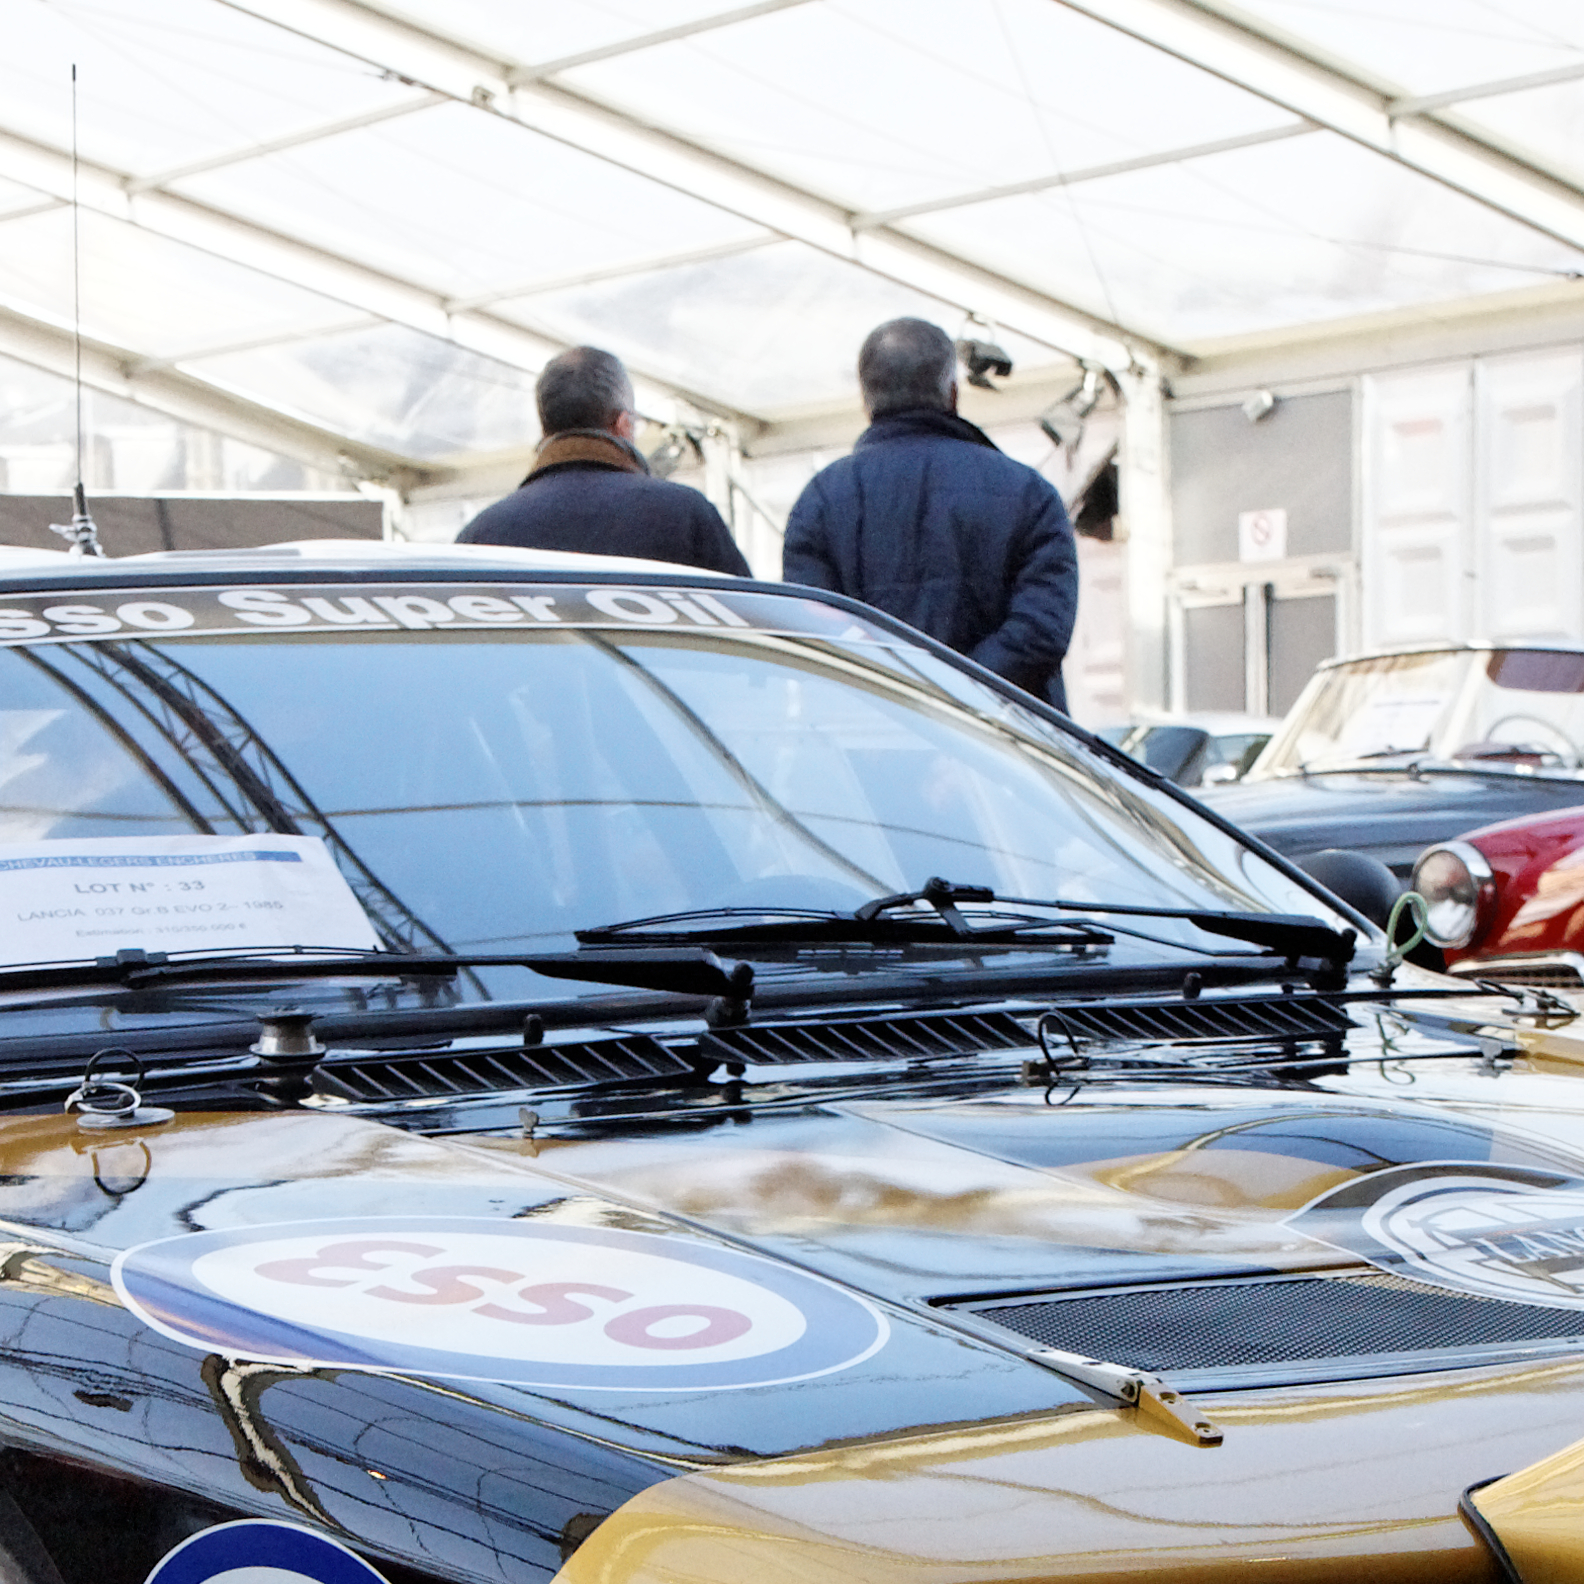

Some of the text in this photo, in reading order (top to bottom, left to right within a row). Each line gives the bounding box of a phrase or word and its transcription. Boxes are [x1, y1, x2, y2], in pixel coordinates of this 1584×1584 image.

[217, 588, 564, 630] Super
[585, 588, 751, 628] Oil
[74, 882, 120, 895] LOT
[129, 881, 155, 894] N°
[179, 880, 206, 892] 33
[18, 907, 86, 922] LANCIA
[174, 903, 213, 914] EVO
[252, 1239, 753, 1351] Esso
